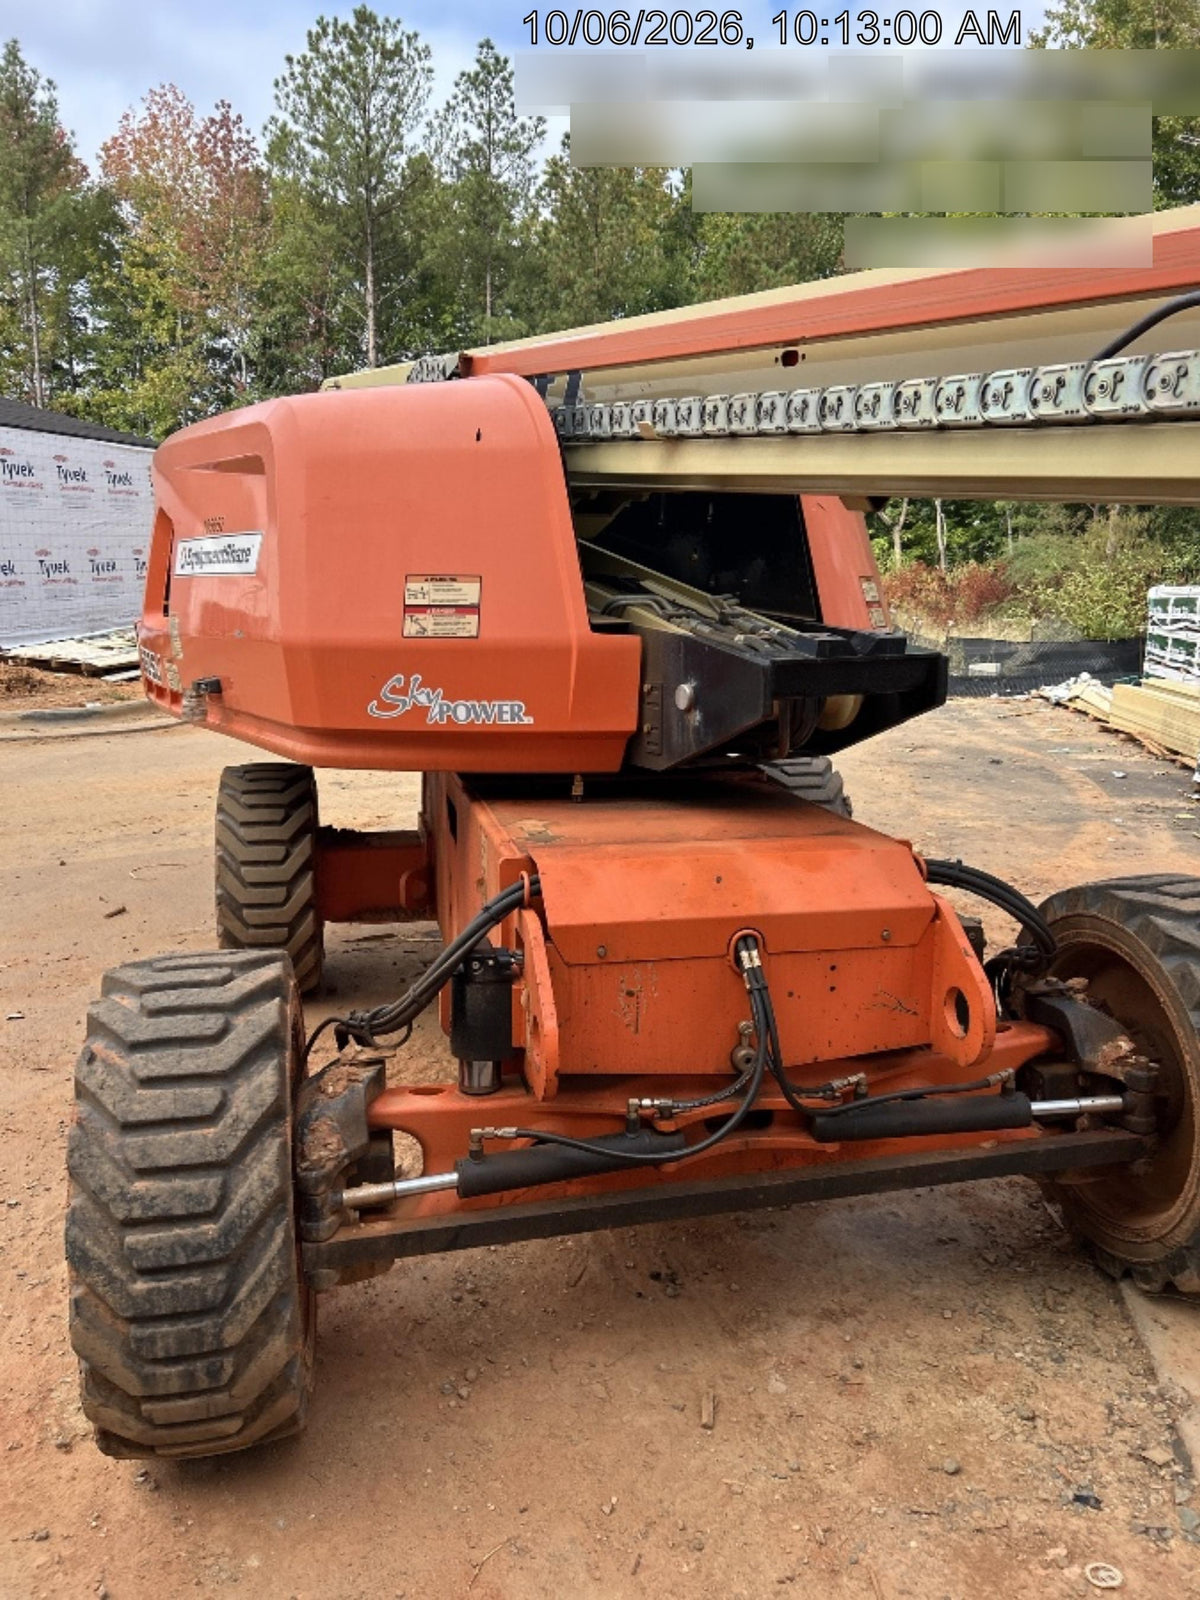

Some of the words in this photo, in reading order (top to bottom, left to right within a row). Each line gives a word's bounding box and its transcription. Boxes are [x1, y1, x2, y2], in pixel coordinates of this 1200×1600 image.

[0, 458, 35, 480] Tyvek
[56, 465, 88, 484] Tyvek
[38, 559, 70, 578] Tyvek
[89, 559, 117, 576] Tyvek
[368, 674, 443, 725] Sky
[437, 699, 527, 725] POWER
